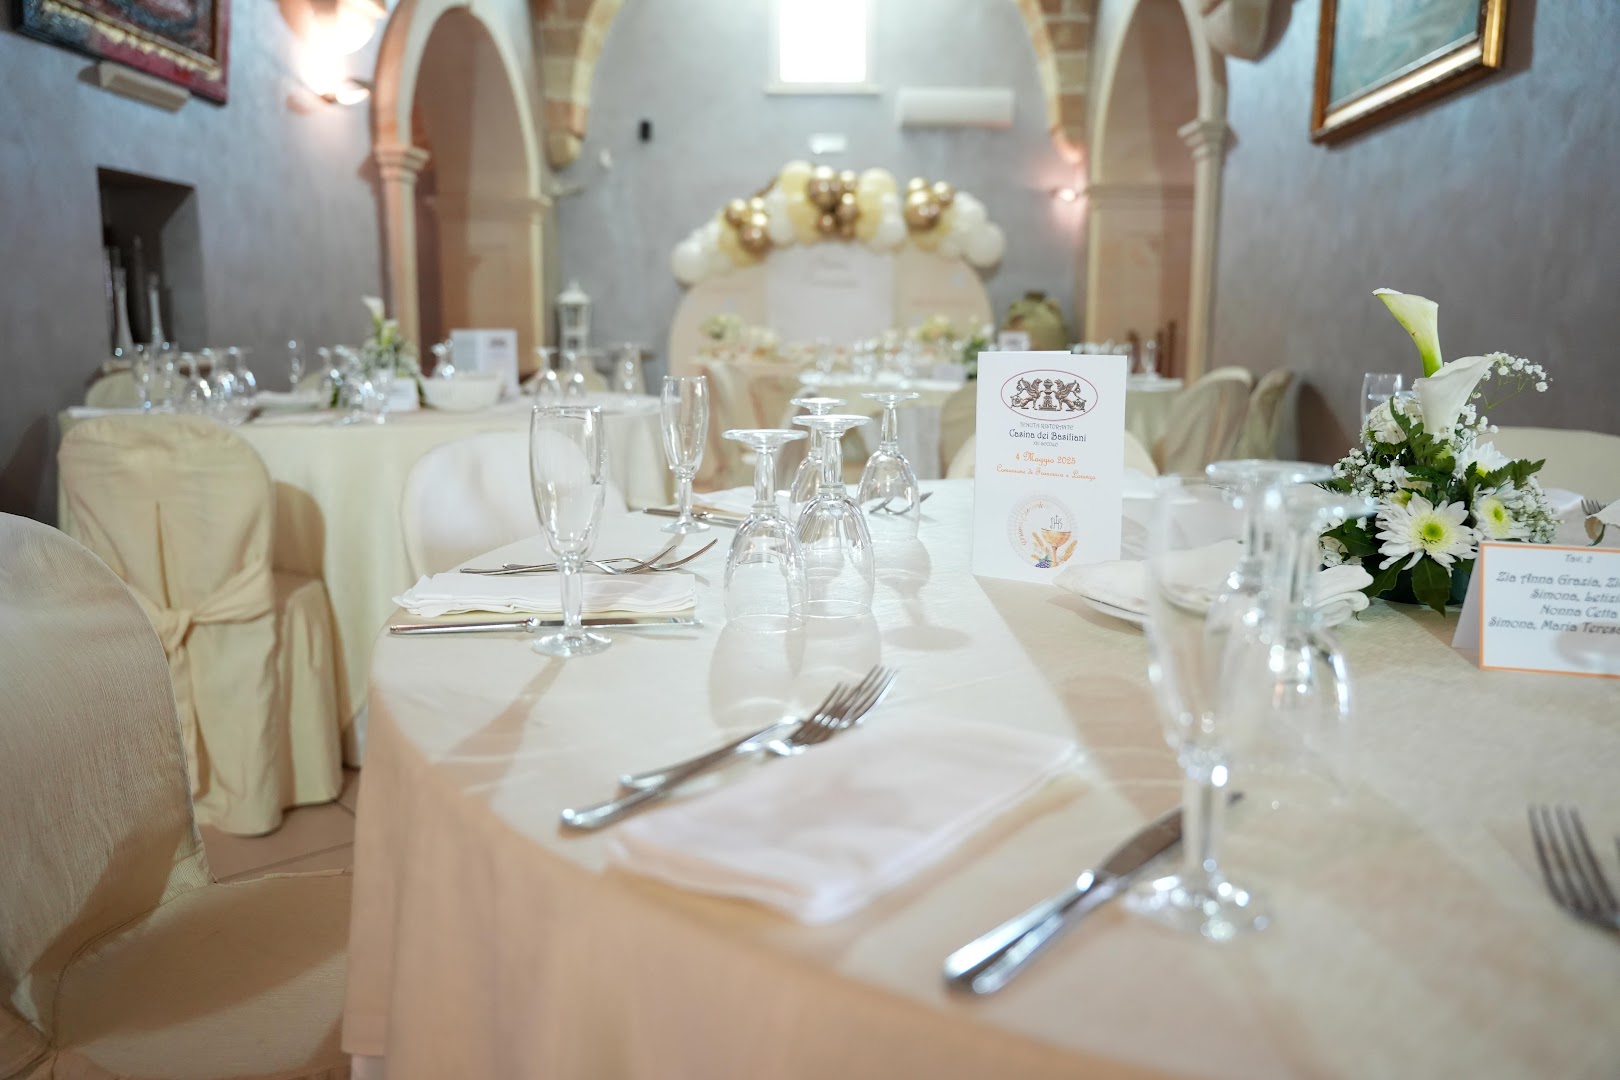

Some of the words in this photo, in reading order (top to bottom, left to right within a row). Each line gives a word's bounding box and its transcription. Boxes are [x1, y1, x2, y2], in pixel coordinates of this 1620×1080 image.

[1008, 428, 1035, 438] Casina
[1037, 431, 1049, 440] dei
[1051, 431, 1087, 442] Basiliani
[1023, 451, 1055, 466] Maggio
[1057, 456, 1076, 465] 2025
[1586, 556, 1593, 564] 2
[1496, 571, 1516, 583] Zia
[1520, 573, 1554, 585] Anna
[1539, 604, 1582, 617] Nonna
[1585, 606, 1618, 619] Cetta
[1540, 619, 1578, 633] Maria
